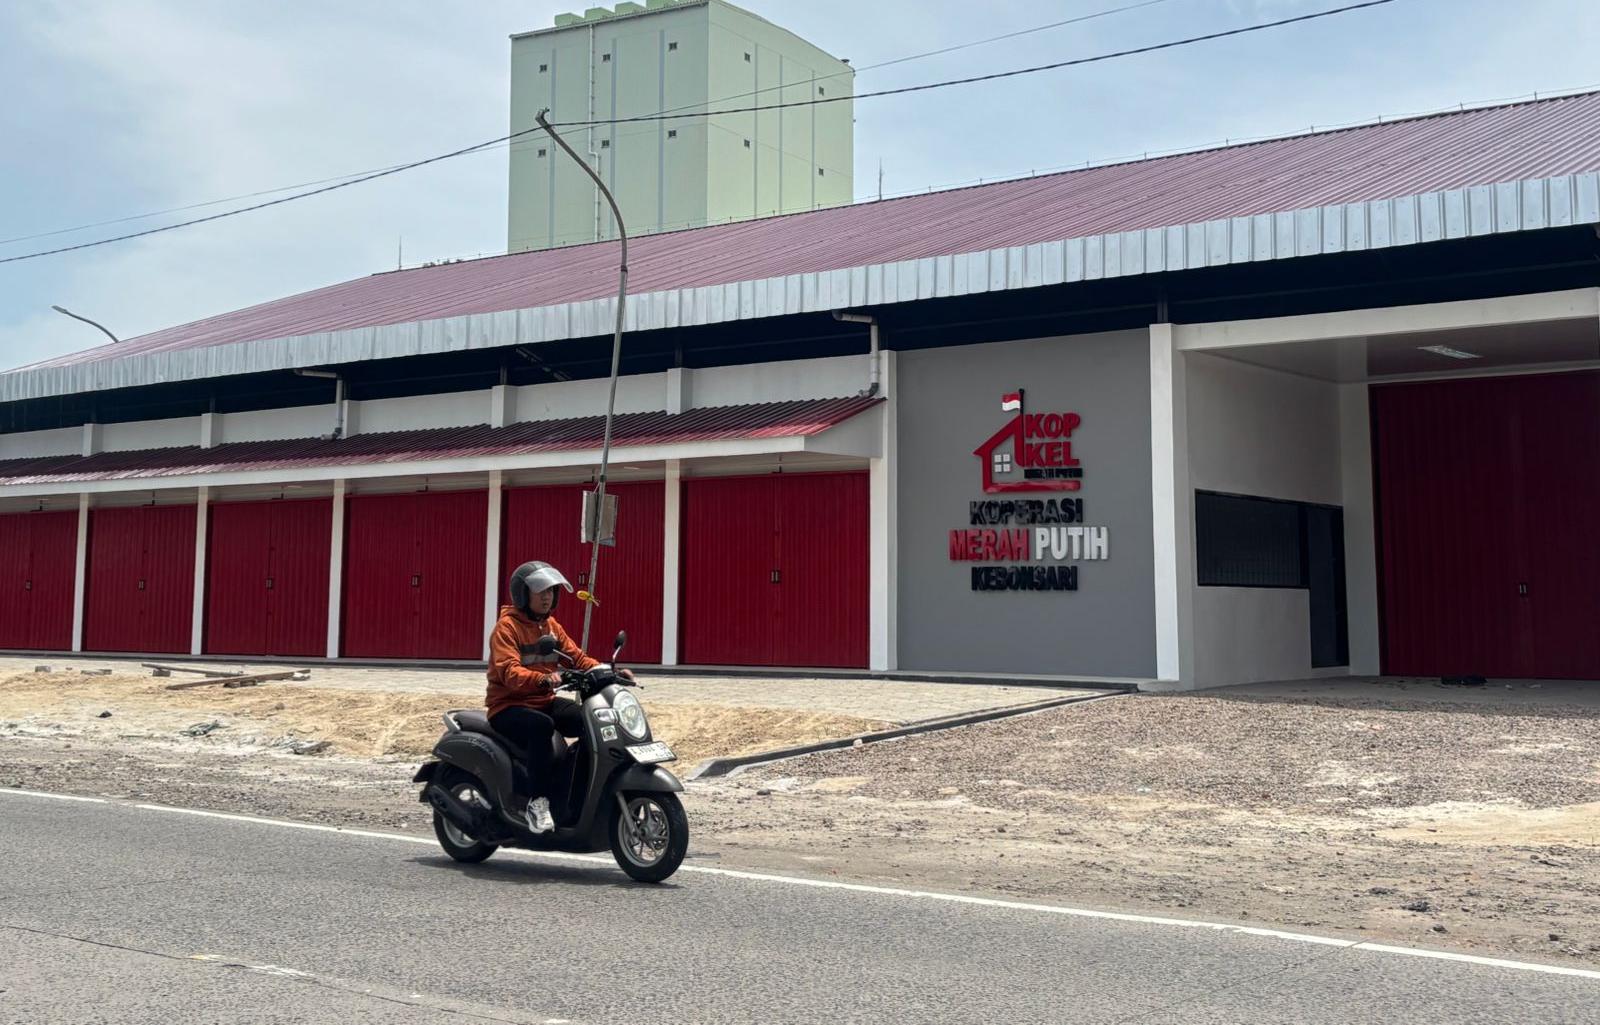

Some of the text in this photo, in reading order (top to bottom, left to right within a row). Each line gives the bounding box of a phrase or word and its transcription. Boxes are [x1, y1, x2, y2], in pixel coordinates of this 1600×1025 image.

[1024, 412, 1081, 439] KOP
[1024, 441, 1080, 467] KEL
[969, 498, 1084, 525] KOPERASI
[949, 526, 1109, 561] MERAH PUTIH
[971, 565, 1079, 591] KEBONSARI
